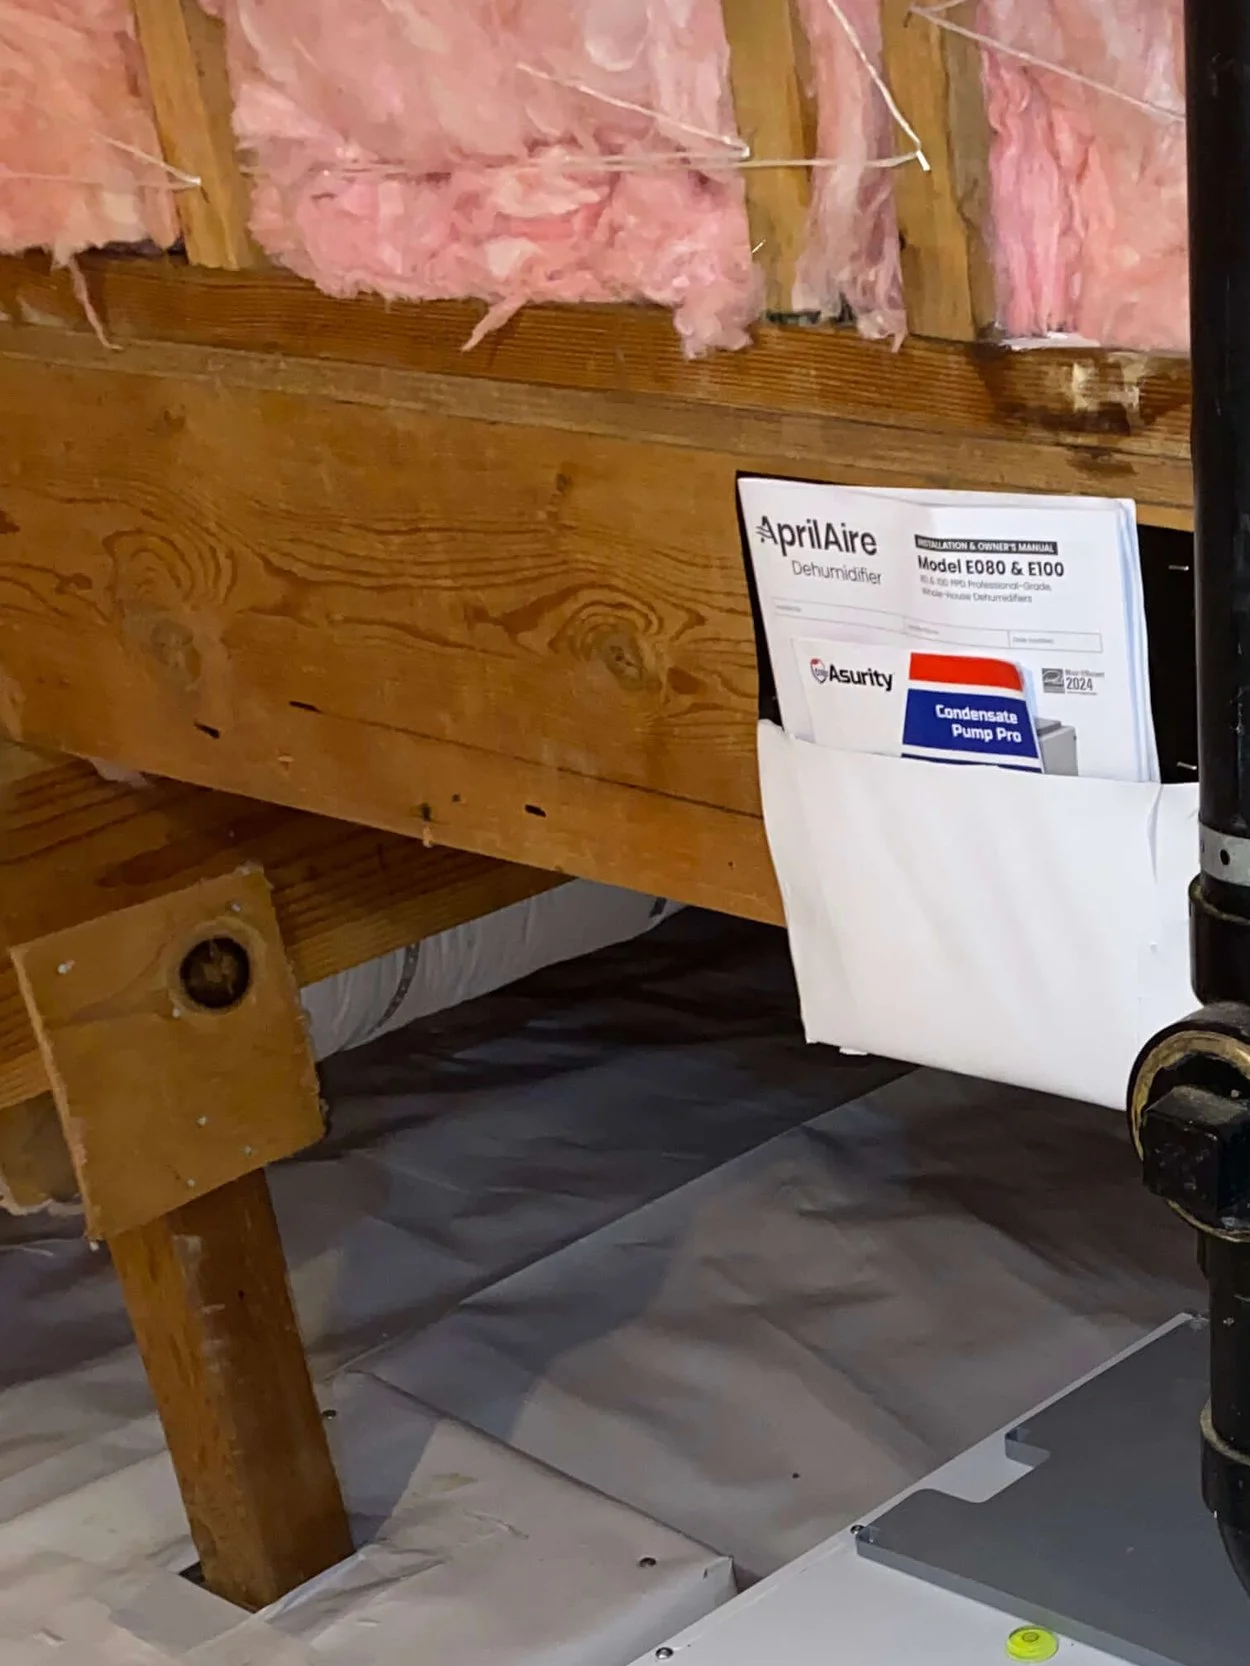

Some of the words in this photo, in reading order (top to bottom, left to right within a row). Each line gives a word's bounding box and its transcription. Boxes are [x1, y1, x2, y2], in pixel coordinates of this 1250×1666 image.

[755, 515, 878, 557] AprilAire
[977, 541, 1016, 551] OWNER'S
[1018, 543, 1055, 553] MANUAL
[791, 560, 882, 585] Dehumidifier
[917, 555, 962, 573] Model
[966, 559, 1006, 575] E080
[1011, 561, 1024, 576] &
[1028, 562, 1065, 577] E100
[829, 664, 893, 691] Asurity
[1066, 677, 1093, 691] 2024
[935, 703, 1018, 724] Condensate
[951, 723, 993, 743] Pump
[996, 726, 1022, 743] Pro
